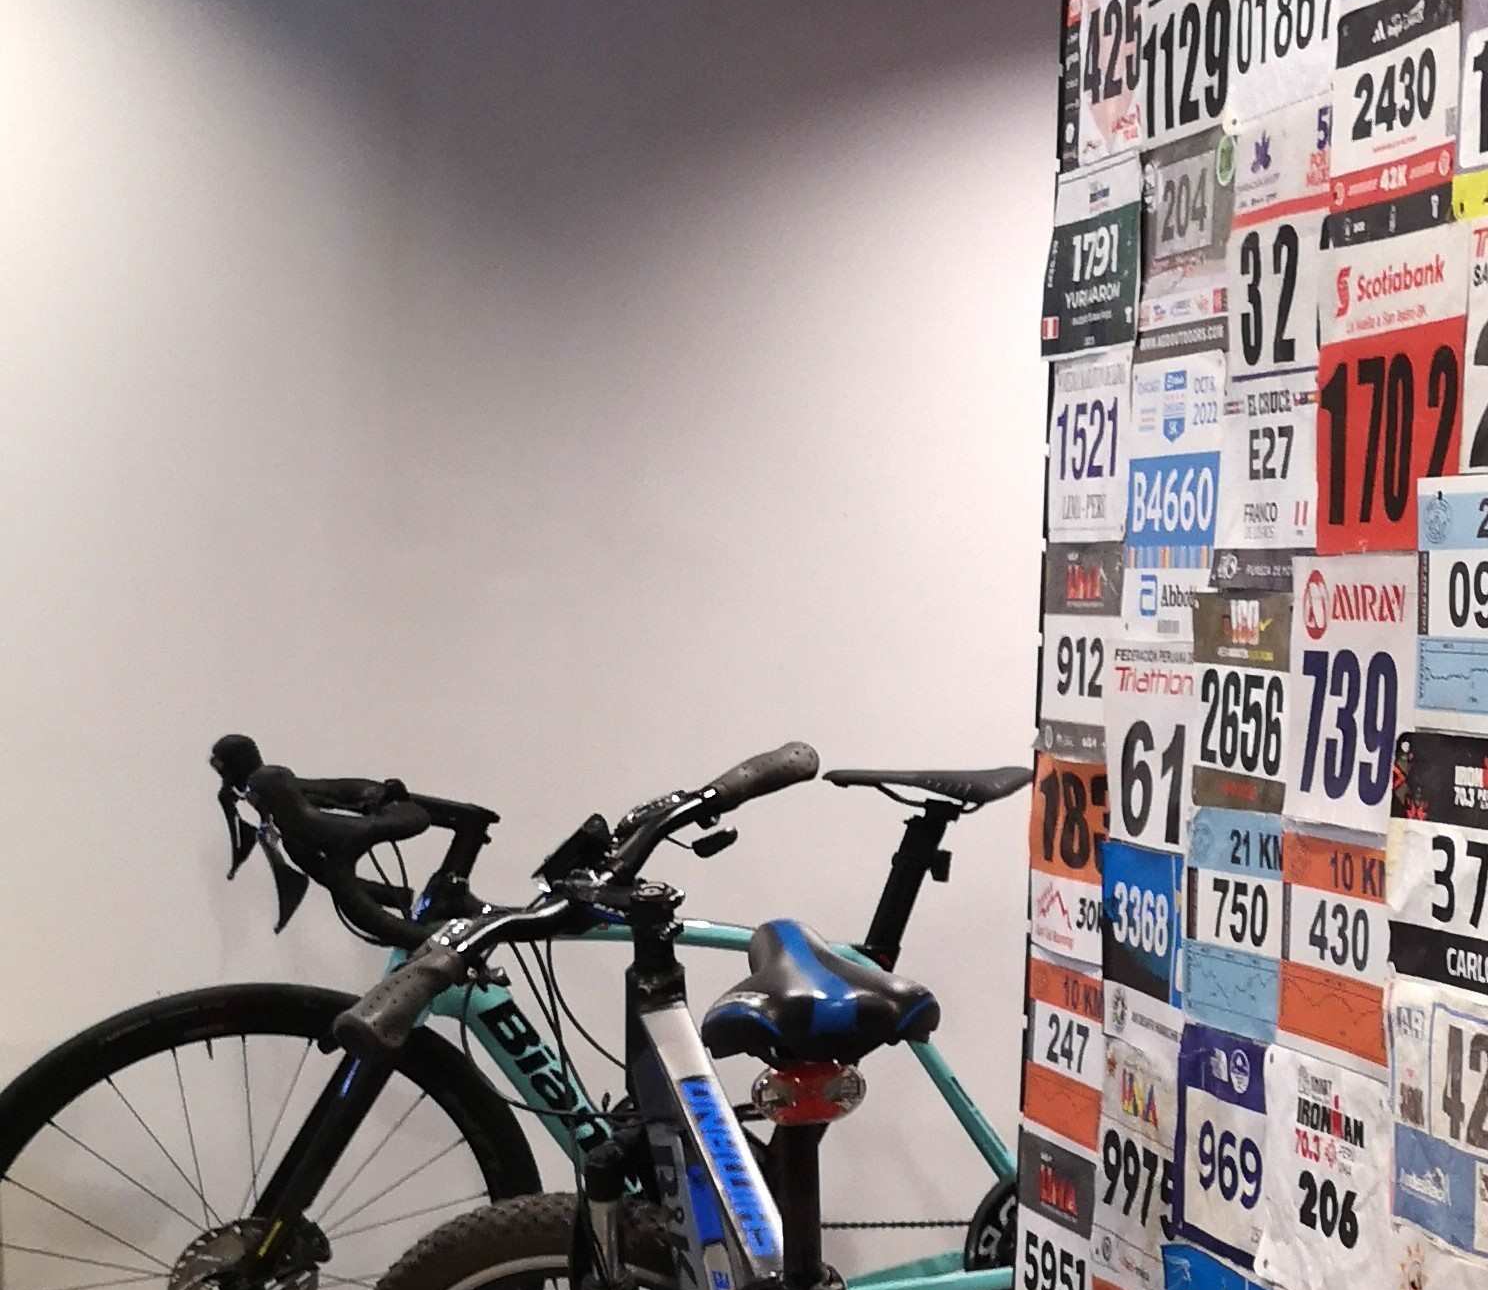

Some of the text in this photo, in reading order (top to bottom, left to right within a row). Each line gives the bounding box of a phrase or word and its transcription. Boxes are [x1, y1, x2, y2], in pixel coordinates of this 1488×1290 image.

[1352, 47, 1437, 142] 2430
[1241, 223, 1299, 366] 32
[1357, 254, 1446, 303] Scotiabank
[1056, 395, 1118, 481] 1521
[1248, 426, 1295, 481] E27
[1319, 344, 1458, 526] 1702
[1131, 467, 1215, 536] B4660
[1244, 500, 1279, 526] FRANCO
[1332, 582, 1408, 623] MIRAY
[1115, 666, 1195, 696] Triathlon
[1200, 668, 1284, 777] 2656
[1300, 648, 1399, 807] 739
[1120, 719, 1187, 845] 61
[1113, 881, 1170, 957] 3368
[1212, 878, 1270, 949] 750
[1309, 899, 1371, 973] 430
[1046, 1012, 1090, 1075] 247
[1198, 1120, 1264, 1211] 969
[1298, 1170, 1359, 1250] 206
